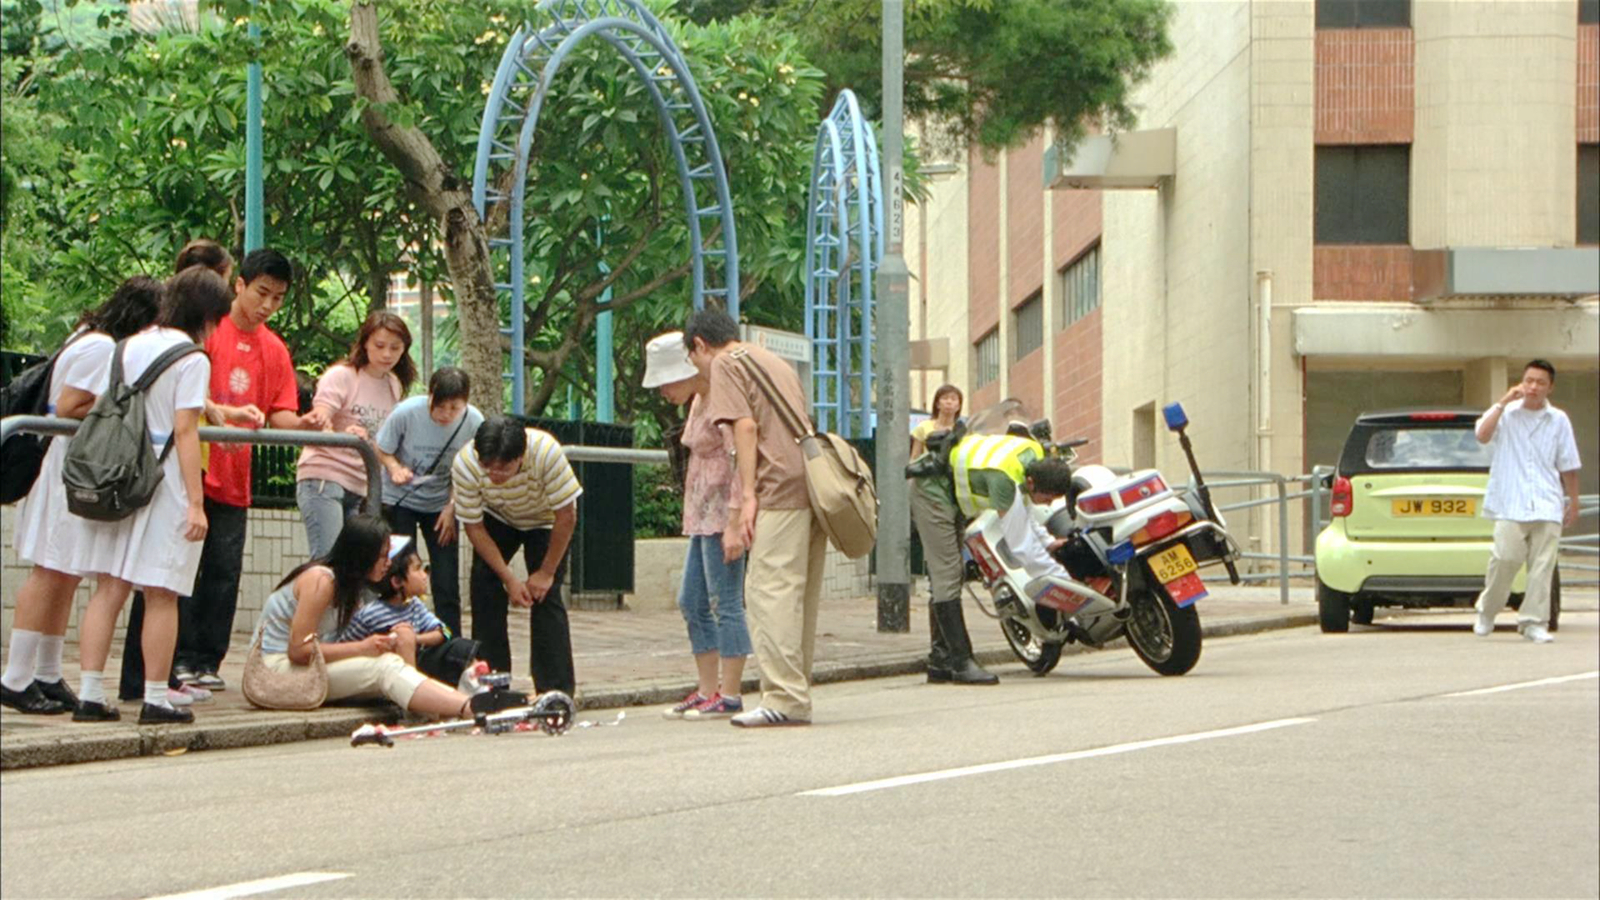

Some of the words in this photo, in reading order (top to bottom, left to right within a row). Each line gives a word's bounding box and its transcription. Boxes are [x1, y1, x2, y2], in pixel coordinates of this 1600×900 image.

[1400, 500, 1423, 514] JW
[1431, 499, 1467, 514] 932
[1161, 551, 1178, 566] AM
[1159, 558, 1193, 579] 6256
